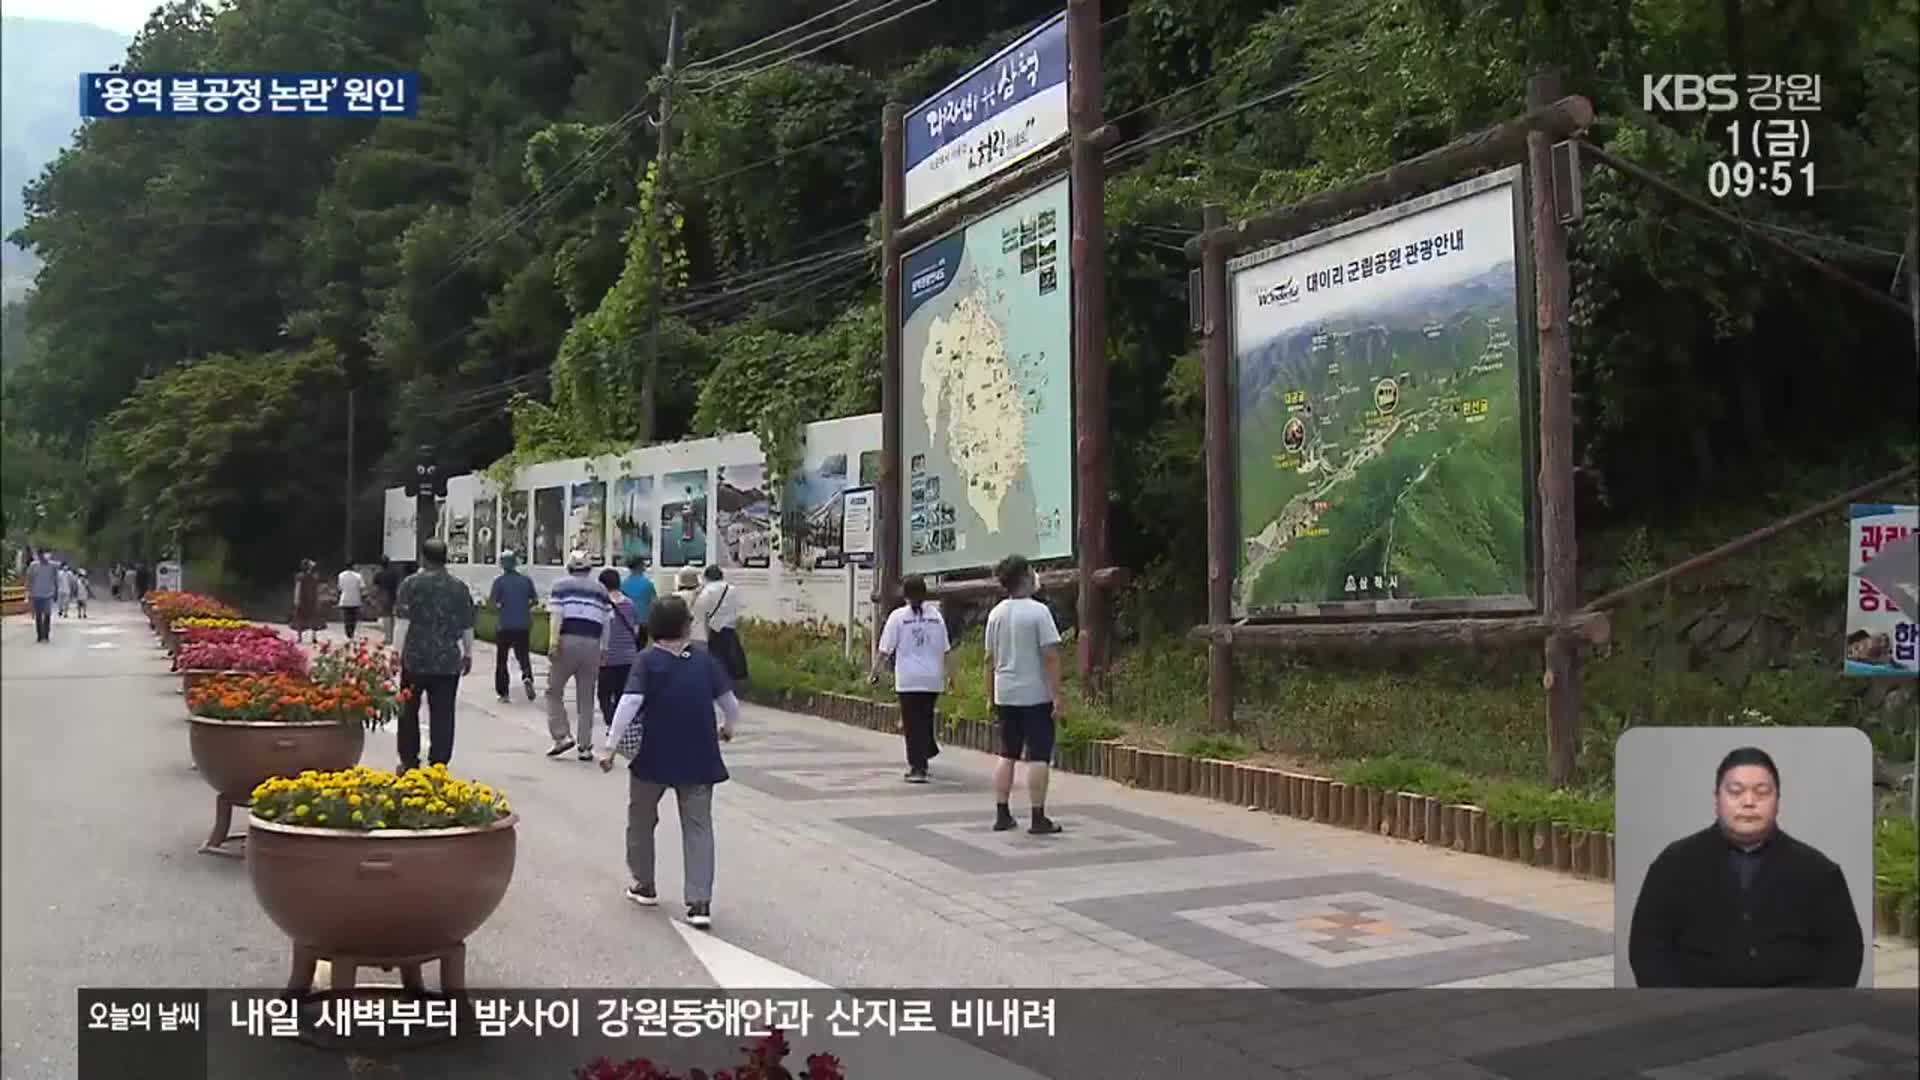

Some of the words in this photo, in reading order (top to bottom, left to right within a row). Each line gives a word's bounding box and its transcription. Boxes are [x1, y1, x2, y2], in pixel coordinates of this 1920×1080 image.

[1306, 264, 1344, 292] 대이리
[1347, 248, 1402, 282] 군립공원
[1404, 228, 1465, 264] 관광안내
